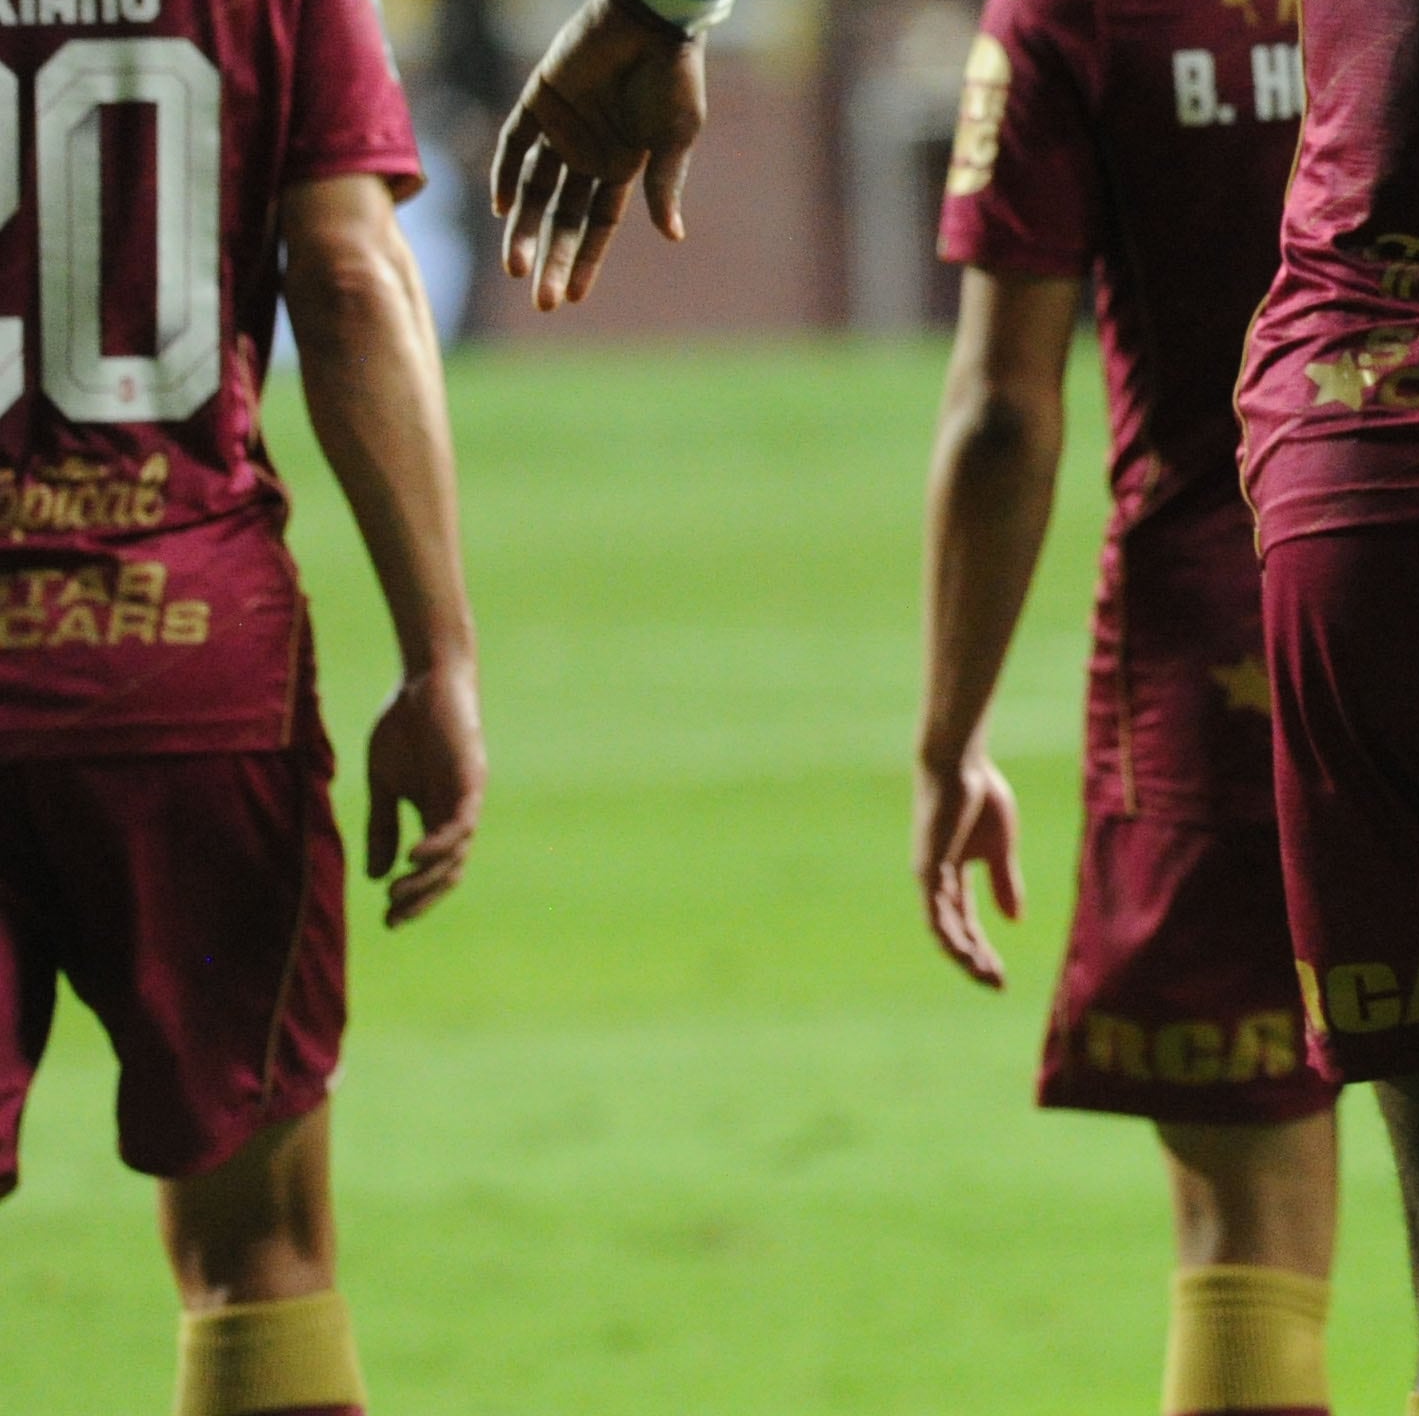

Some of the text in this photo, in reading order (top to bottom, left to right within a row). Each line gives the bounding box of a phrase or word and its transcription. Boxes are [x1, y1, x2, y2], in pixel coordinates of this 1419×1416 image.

[1171, 41, 1305, 127] B. H
[0, 37, 221, 423] 0
